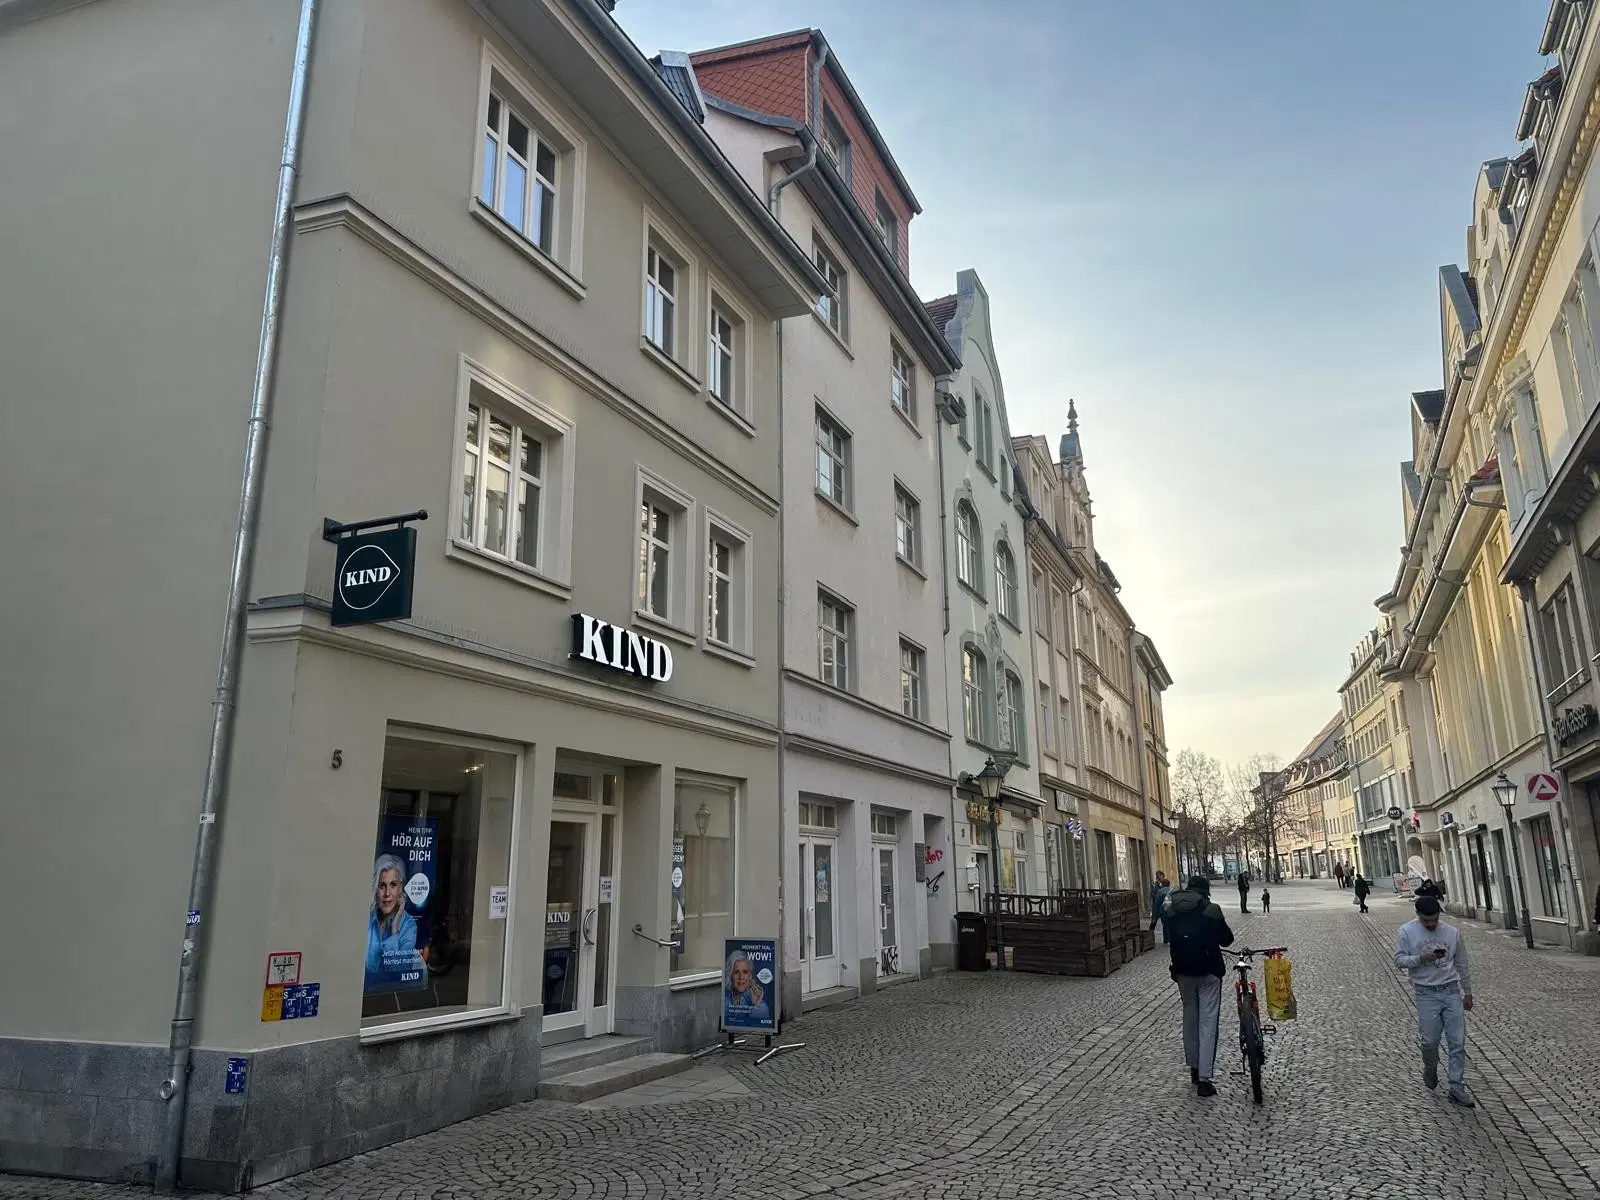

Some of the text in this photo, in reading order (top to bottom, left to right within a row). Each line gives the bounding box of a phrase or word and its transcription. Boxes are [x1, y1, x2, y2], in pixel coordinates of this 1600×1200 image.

[345, 566, 391, 587] KIND
[580, 613, 673, 682] KIND
[332, 749, 343, 770] 5
[391, 833, 433, 848] HÖR AUF
[409, 849, 432, 861] DICH
[492, 895, 506, 903] TEAM
[547, 912, 570, 923] KIND
[747, 952, 772, 961] WOW!
[401, 972, 420, 981] KIND
[284, 991, 289, 999] S
[302, 989, 307, 997] S
[228, 1063, 233, 1071] S
